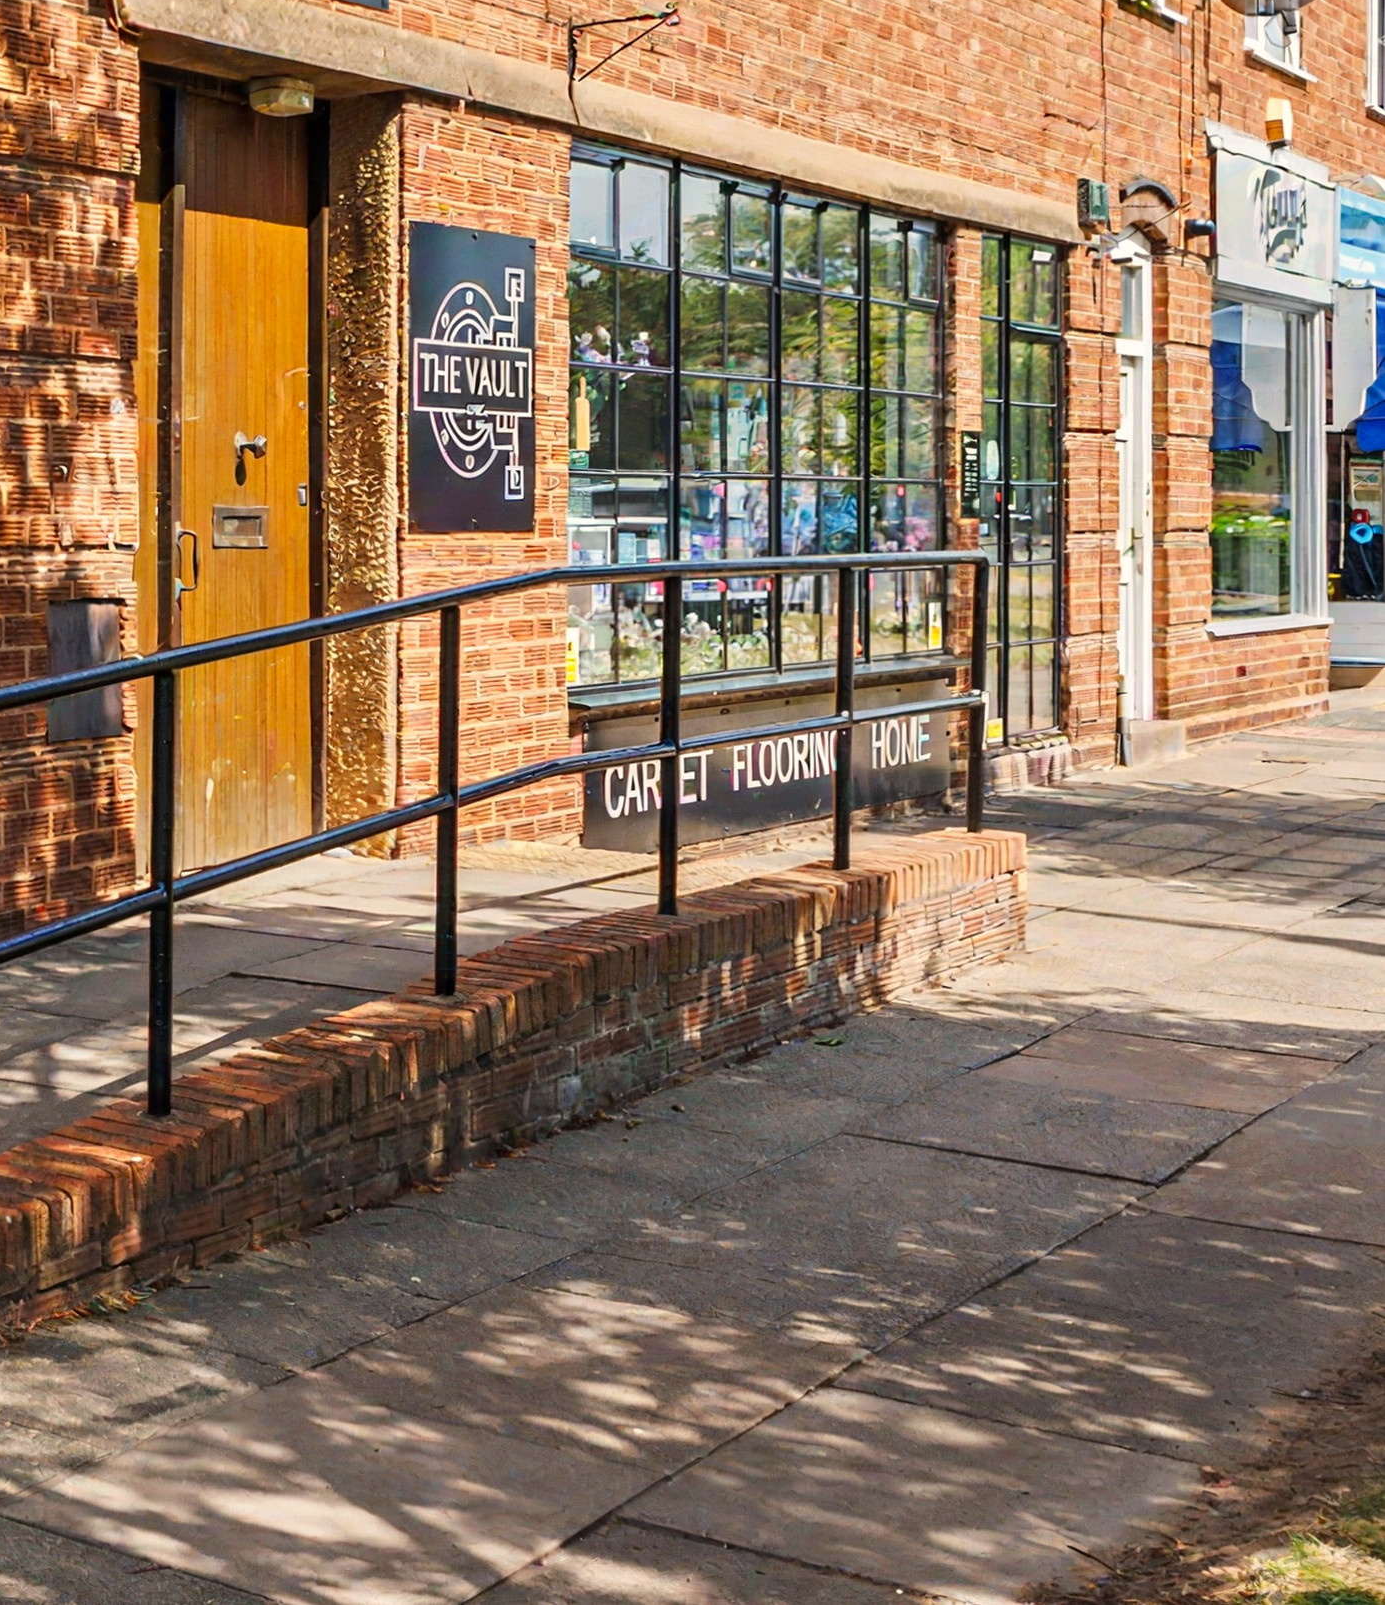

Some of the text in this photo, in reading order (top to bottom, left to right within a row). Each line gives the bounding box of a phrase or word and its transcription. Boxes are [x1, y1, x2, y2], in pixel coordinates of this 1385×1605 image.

[419, 351, 528, 399] THE VAULT
[603, 748, 715, 819] CARET
[870, 714, 932, 769] HOME
